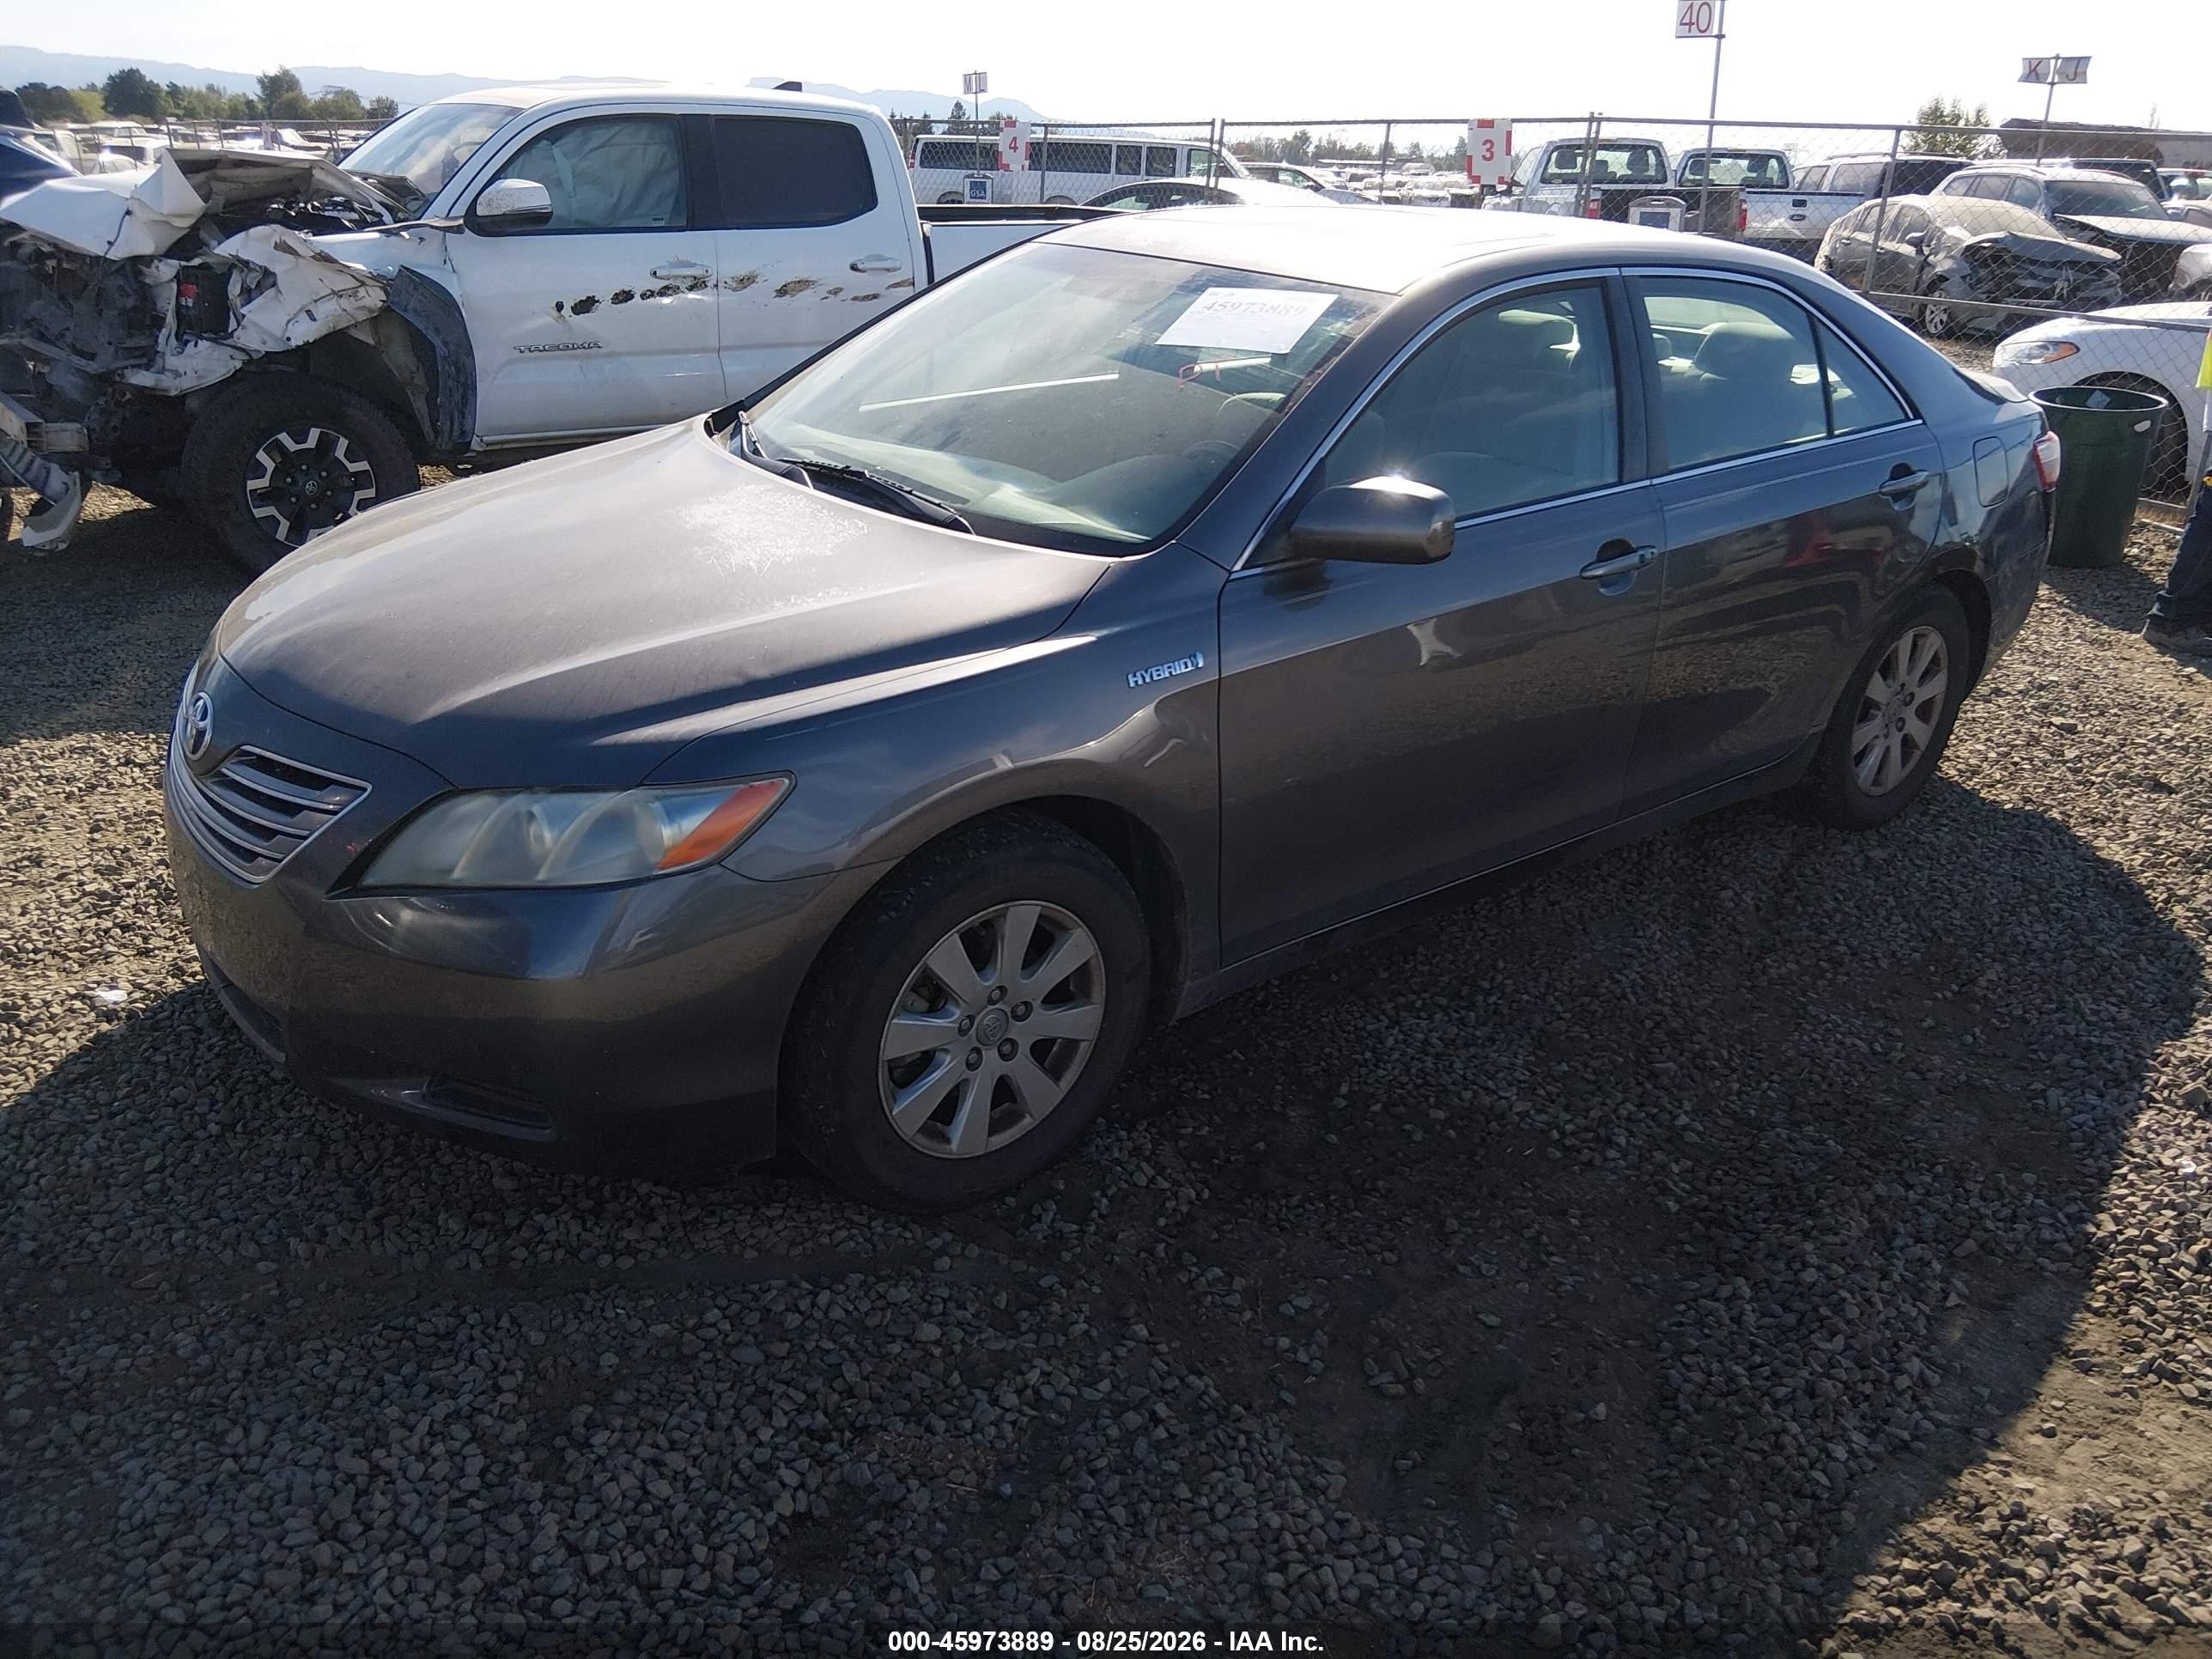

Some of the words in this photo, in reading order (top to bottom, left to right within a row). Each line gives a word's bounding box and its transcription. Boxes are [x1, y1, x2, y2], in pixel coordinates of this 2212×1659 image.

[1680, 2, 1712, 33] 40
[2026, 60, 2043, 81] K
[2066, 58, 2081, 81] J
[979, 74, 986, 92] L
[1008, 136, 1018, 153] 4
[1482, 139, 1494, 161] 3
[970, 189, 986, 198] GSA
[1202, 301, 1307, 316] 45973889
[514, 341, 604, 353] TACOMA
[1127, 657, 1196, 688] HYBRID
